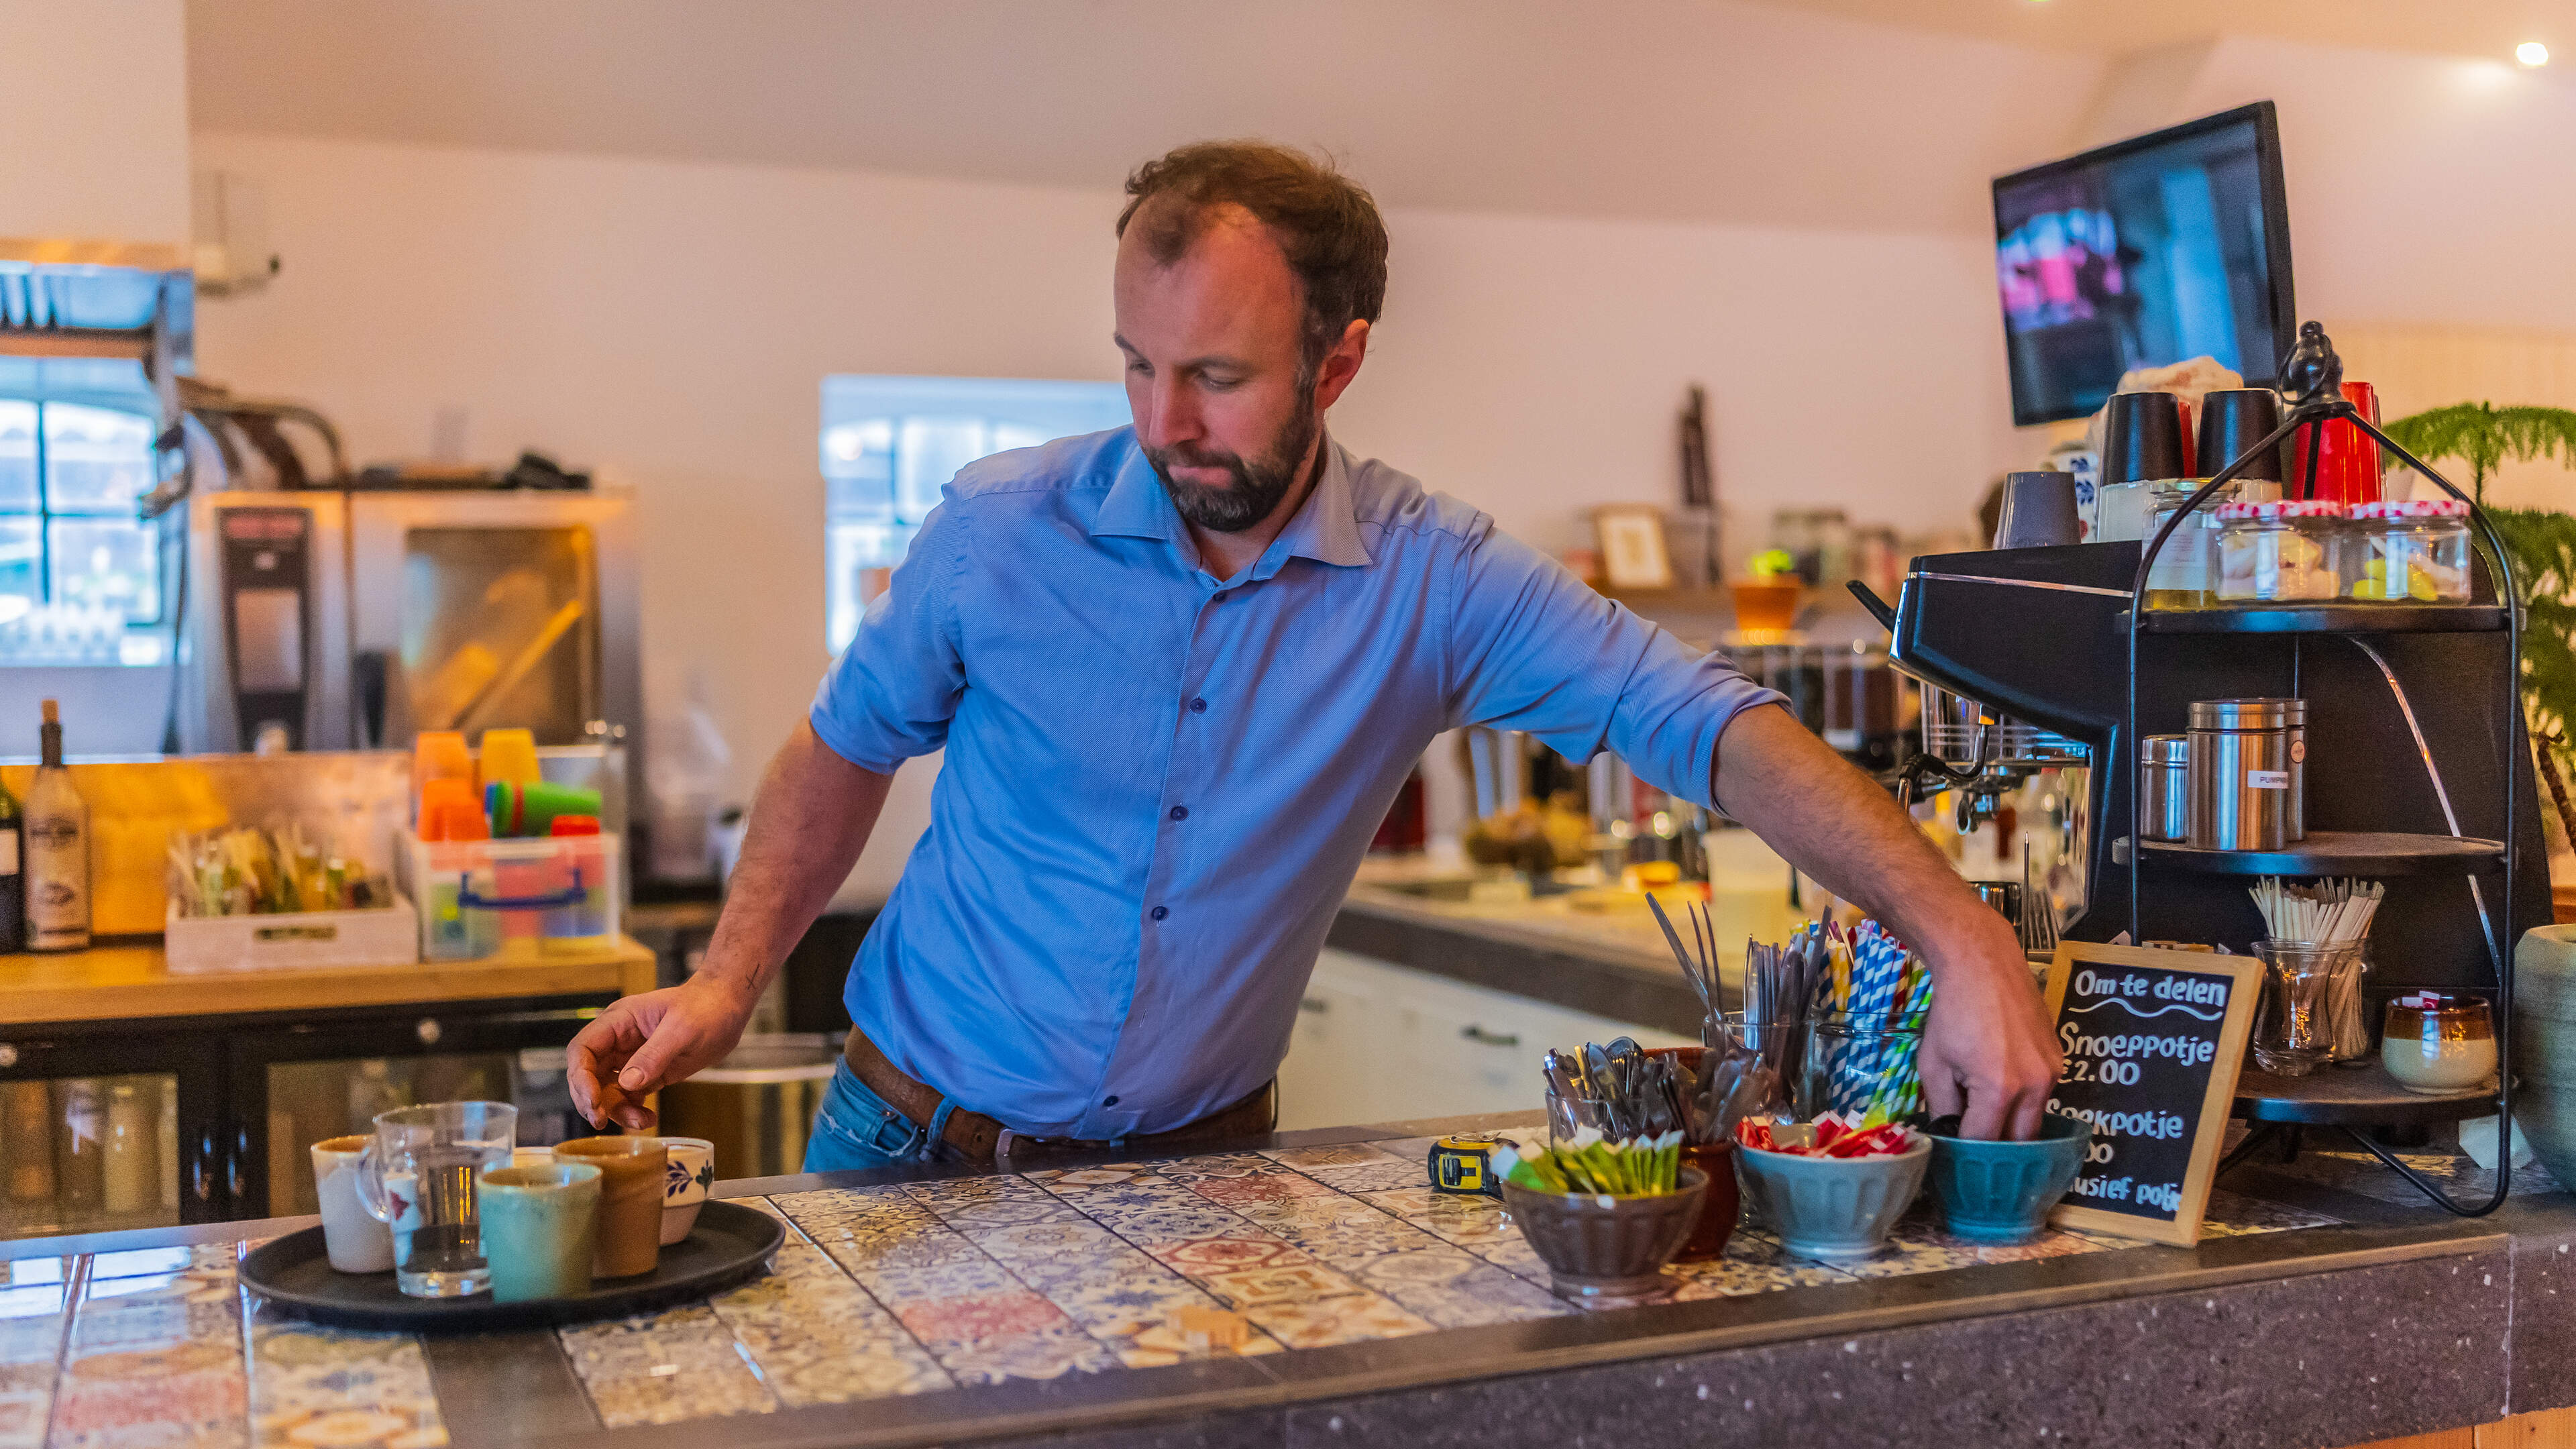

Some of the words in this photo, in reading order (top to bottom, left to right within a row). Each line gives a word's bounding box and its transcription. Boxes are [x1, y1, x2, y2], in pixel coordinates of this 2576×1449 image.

[2075, 970, 2117, 996] Om
[2119, 974, 2149, 996] te
[2153, 975, 2226, 1007] delen
[2060, 1022, 2214, 1067] Snoeppotje
